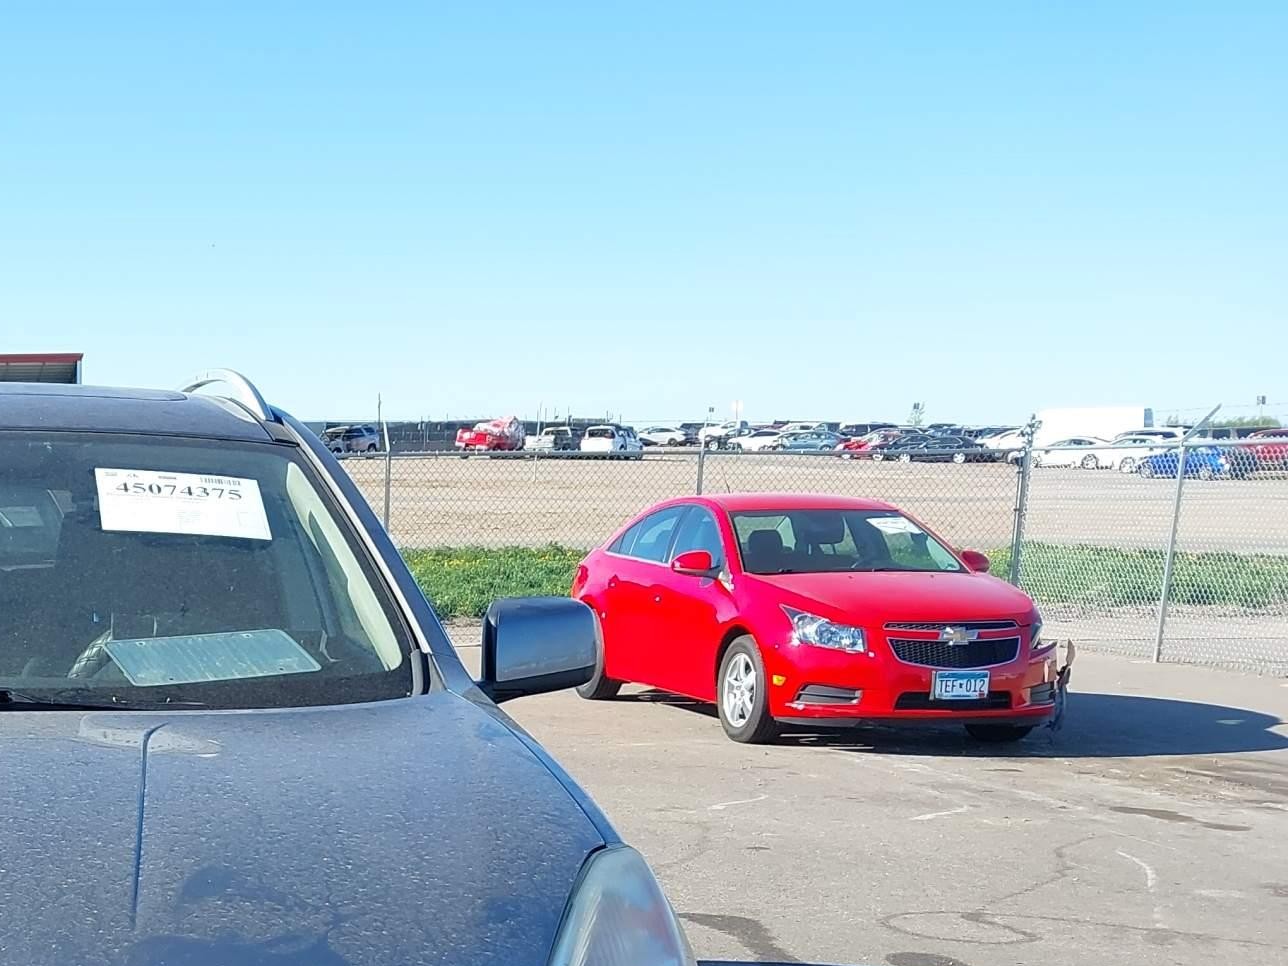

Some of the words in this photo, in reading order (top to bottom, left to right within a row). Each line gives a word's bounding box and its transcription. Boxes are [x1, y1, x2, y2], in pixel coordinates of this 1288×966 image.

[115, 481, 243, 501] 45074375
[939, 680, 957, 693] TEF
[966, 679, 985, 693] 012
